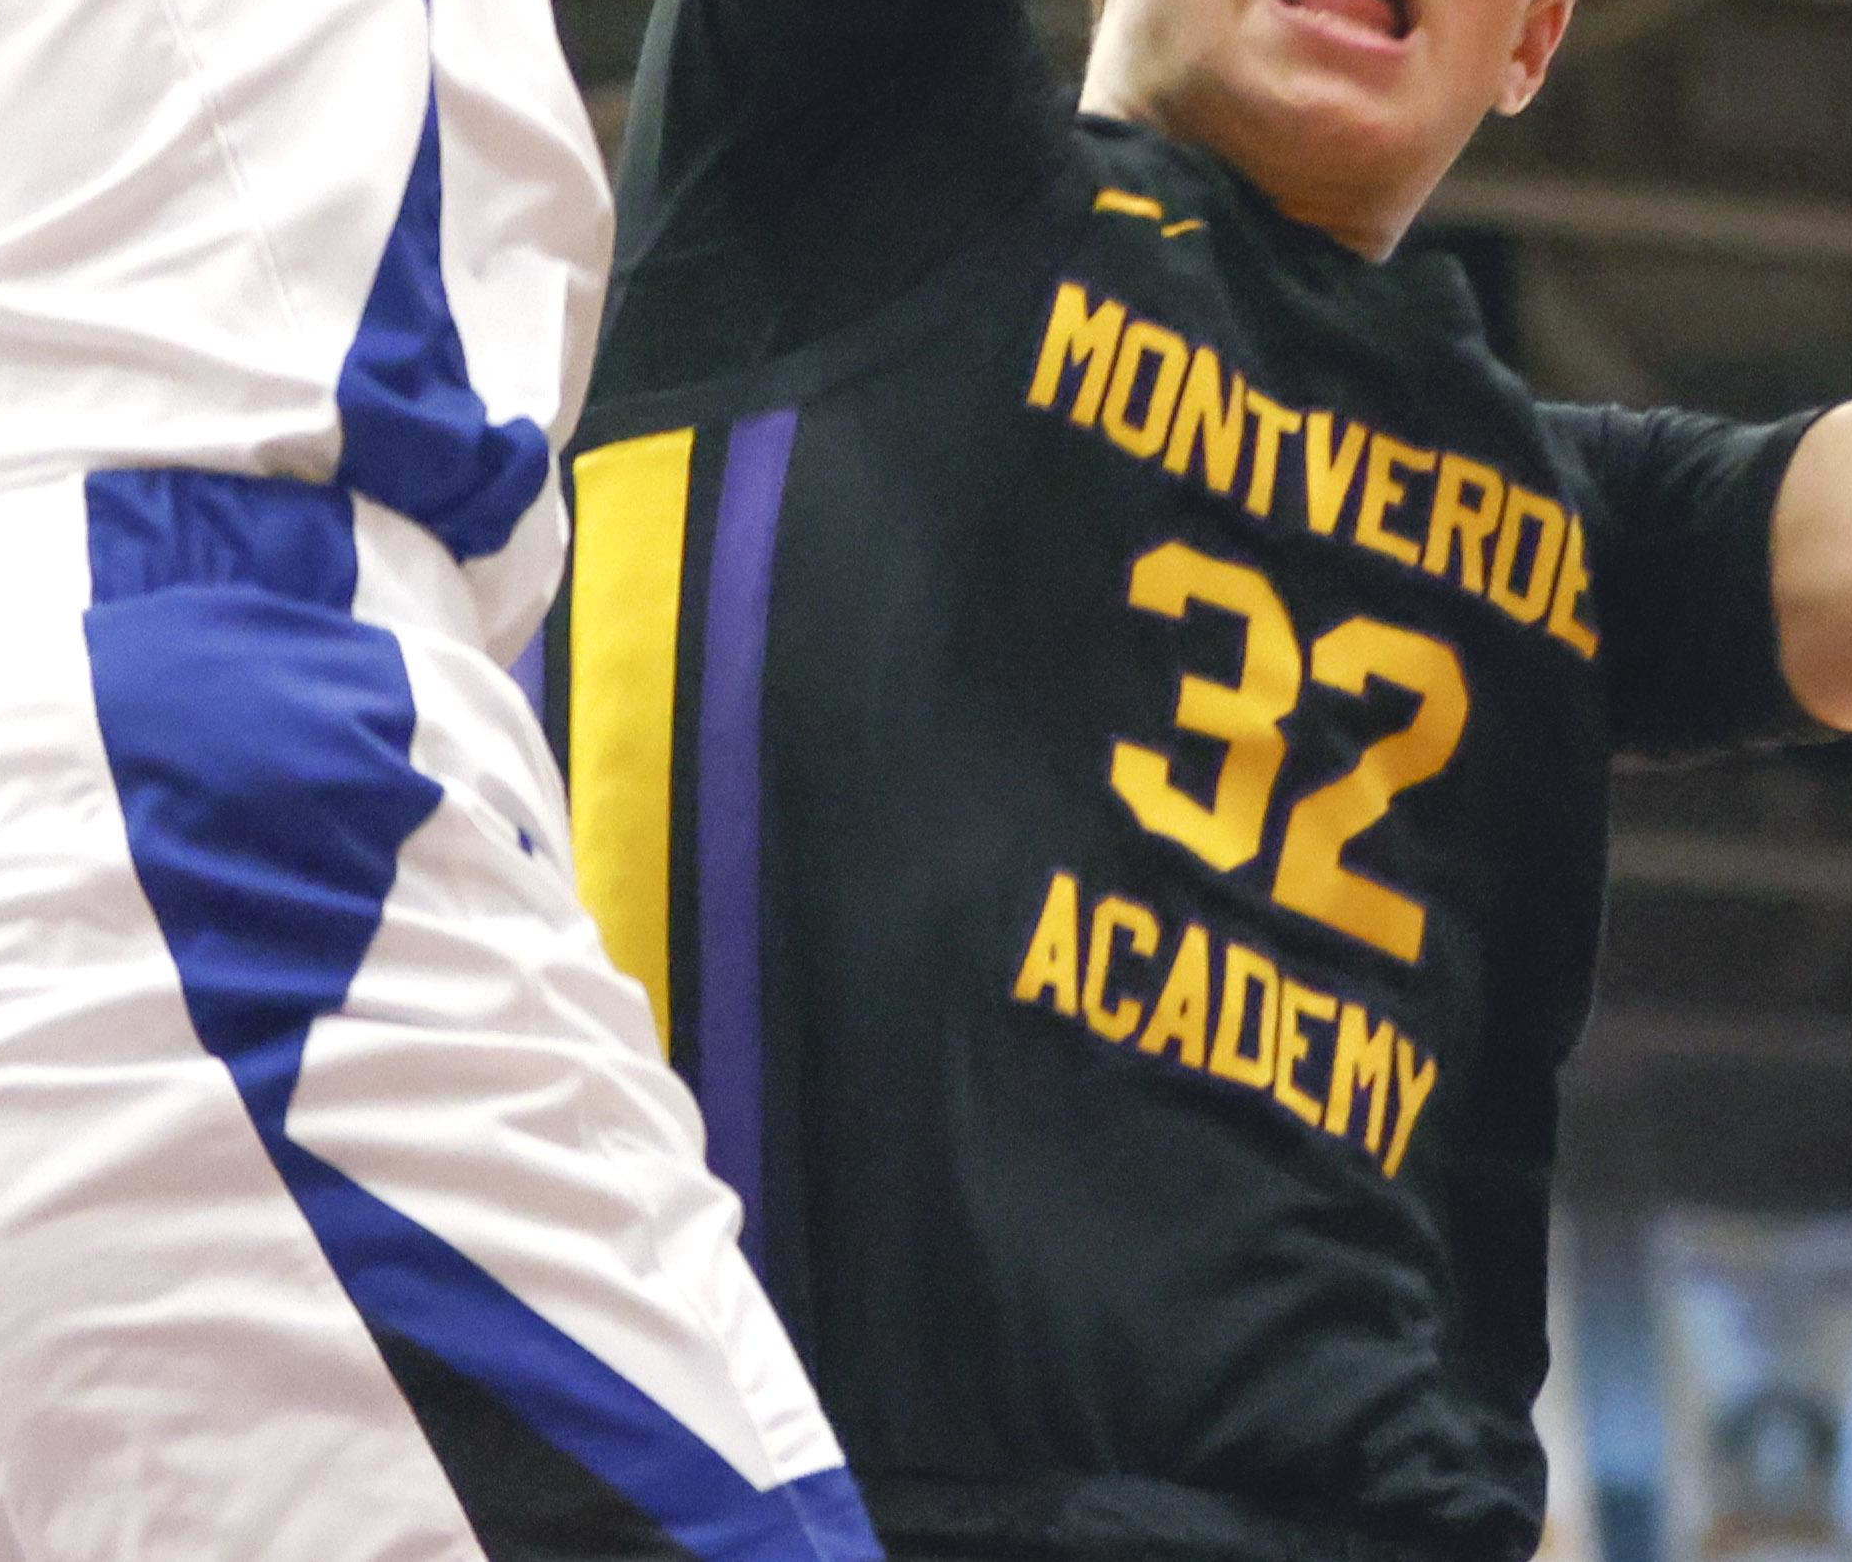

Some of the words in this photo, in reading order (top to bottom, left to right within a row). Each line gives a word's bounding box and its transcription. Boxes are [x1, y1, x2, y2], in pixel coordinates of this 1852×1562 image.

[1026, 281, 1600, 660] MONTVERDE
[1109, 540, 1470, 964] 32
[1012, 871, 1437, 1179] ACADEMY
